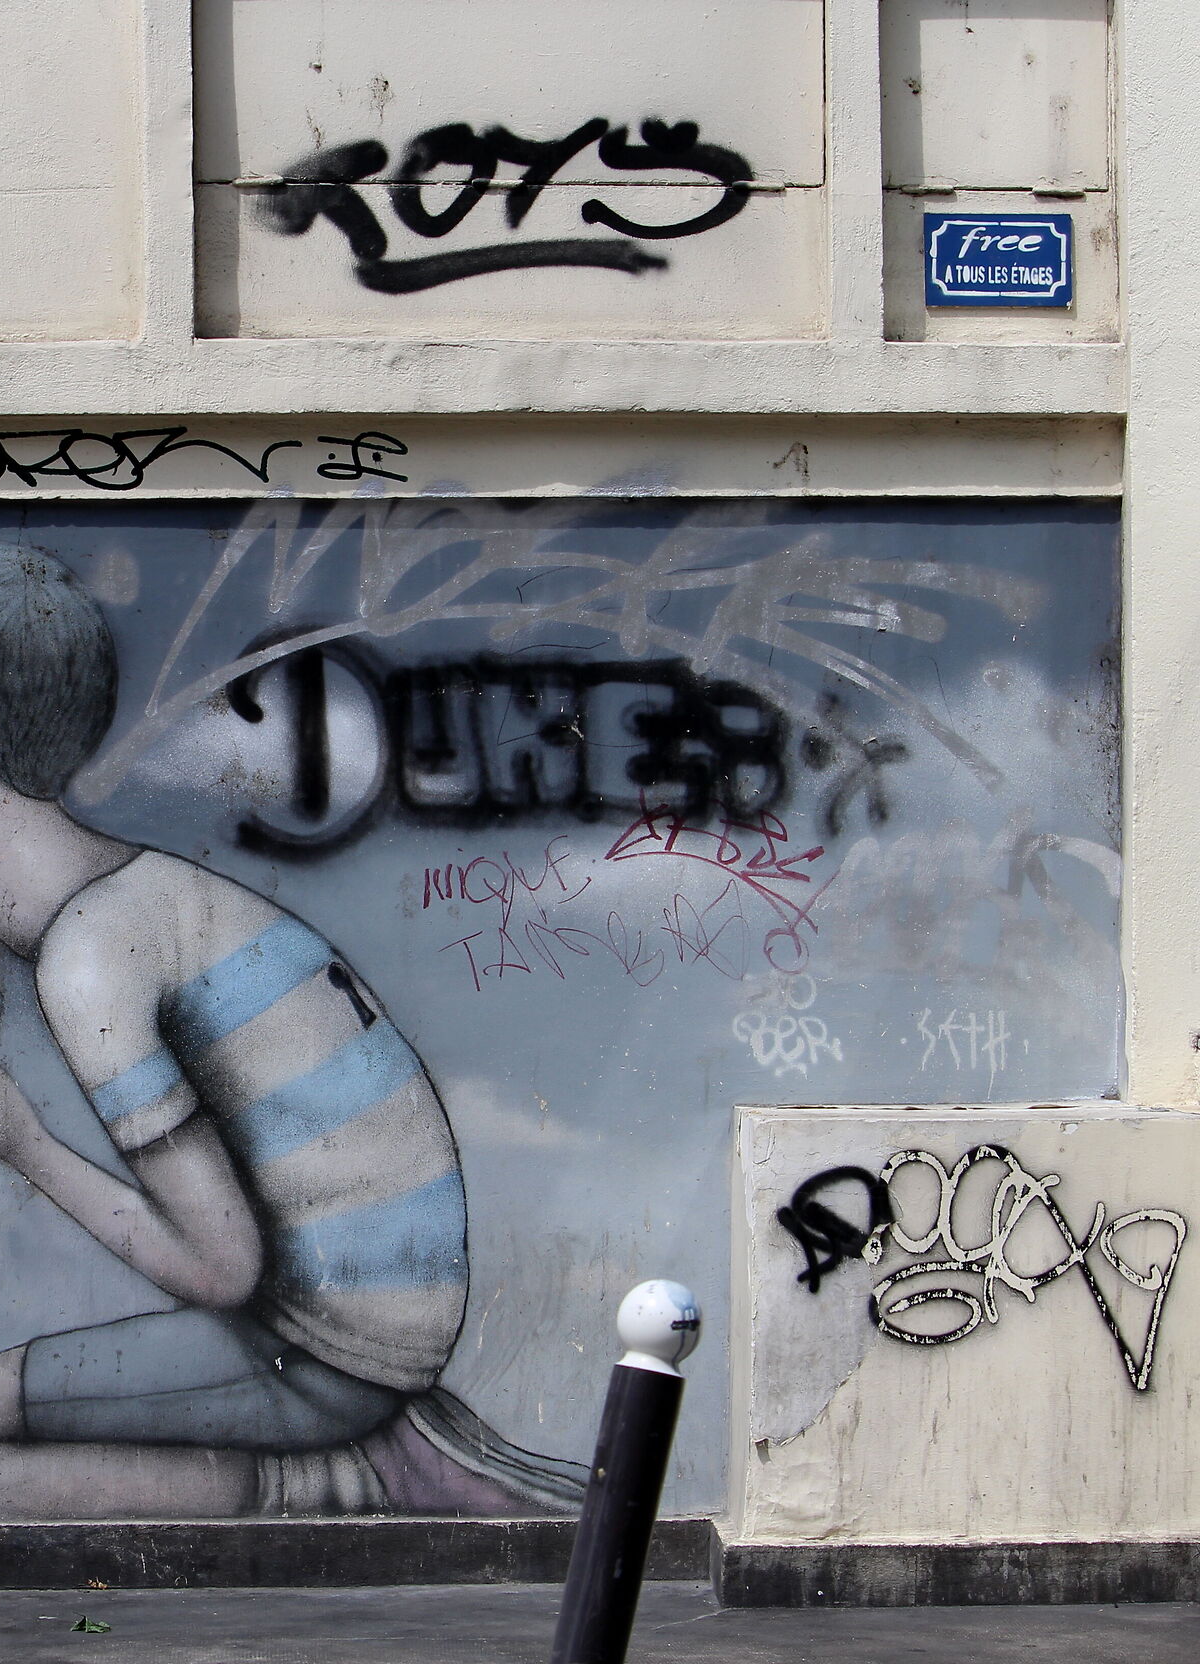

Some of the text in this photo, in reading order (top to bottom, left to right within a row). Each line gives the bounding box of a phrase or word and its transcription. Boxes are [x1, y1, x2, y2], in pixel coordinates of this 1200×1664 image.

[958, 226, 1043, 258] free
[944, 262, 1054, 286] A TOUS LES ÉTAGES
